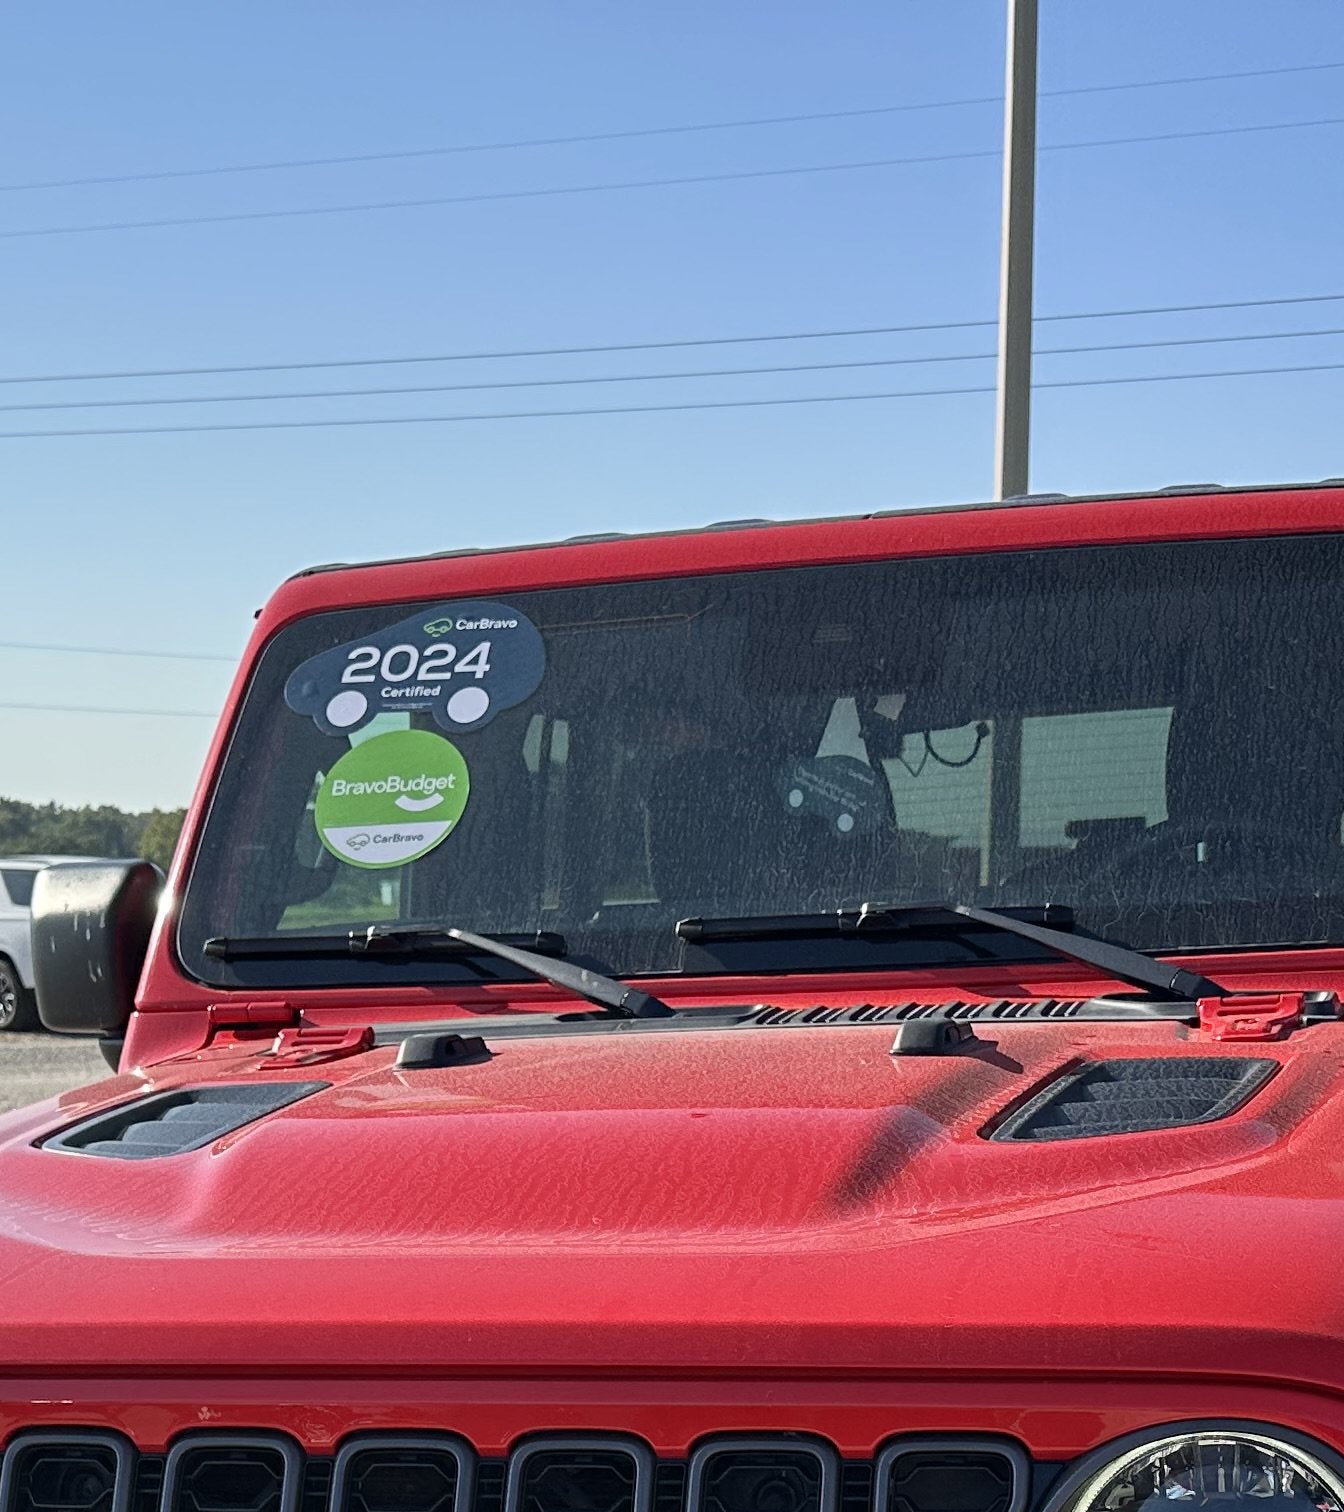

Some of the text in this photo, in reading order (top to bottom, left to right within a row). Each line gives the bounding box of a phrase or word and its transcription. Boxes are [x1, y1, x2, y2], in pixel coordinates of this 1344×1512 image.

[455, 617, 518, 631] CarBravo
[340, 640, 492, 684] 2024
[380, 684, 442, 698] Certified
[331, 772, 457, 797] BravoBudget
[372, 832, 425, 845] CarBravo
